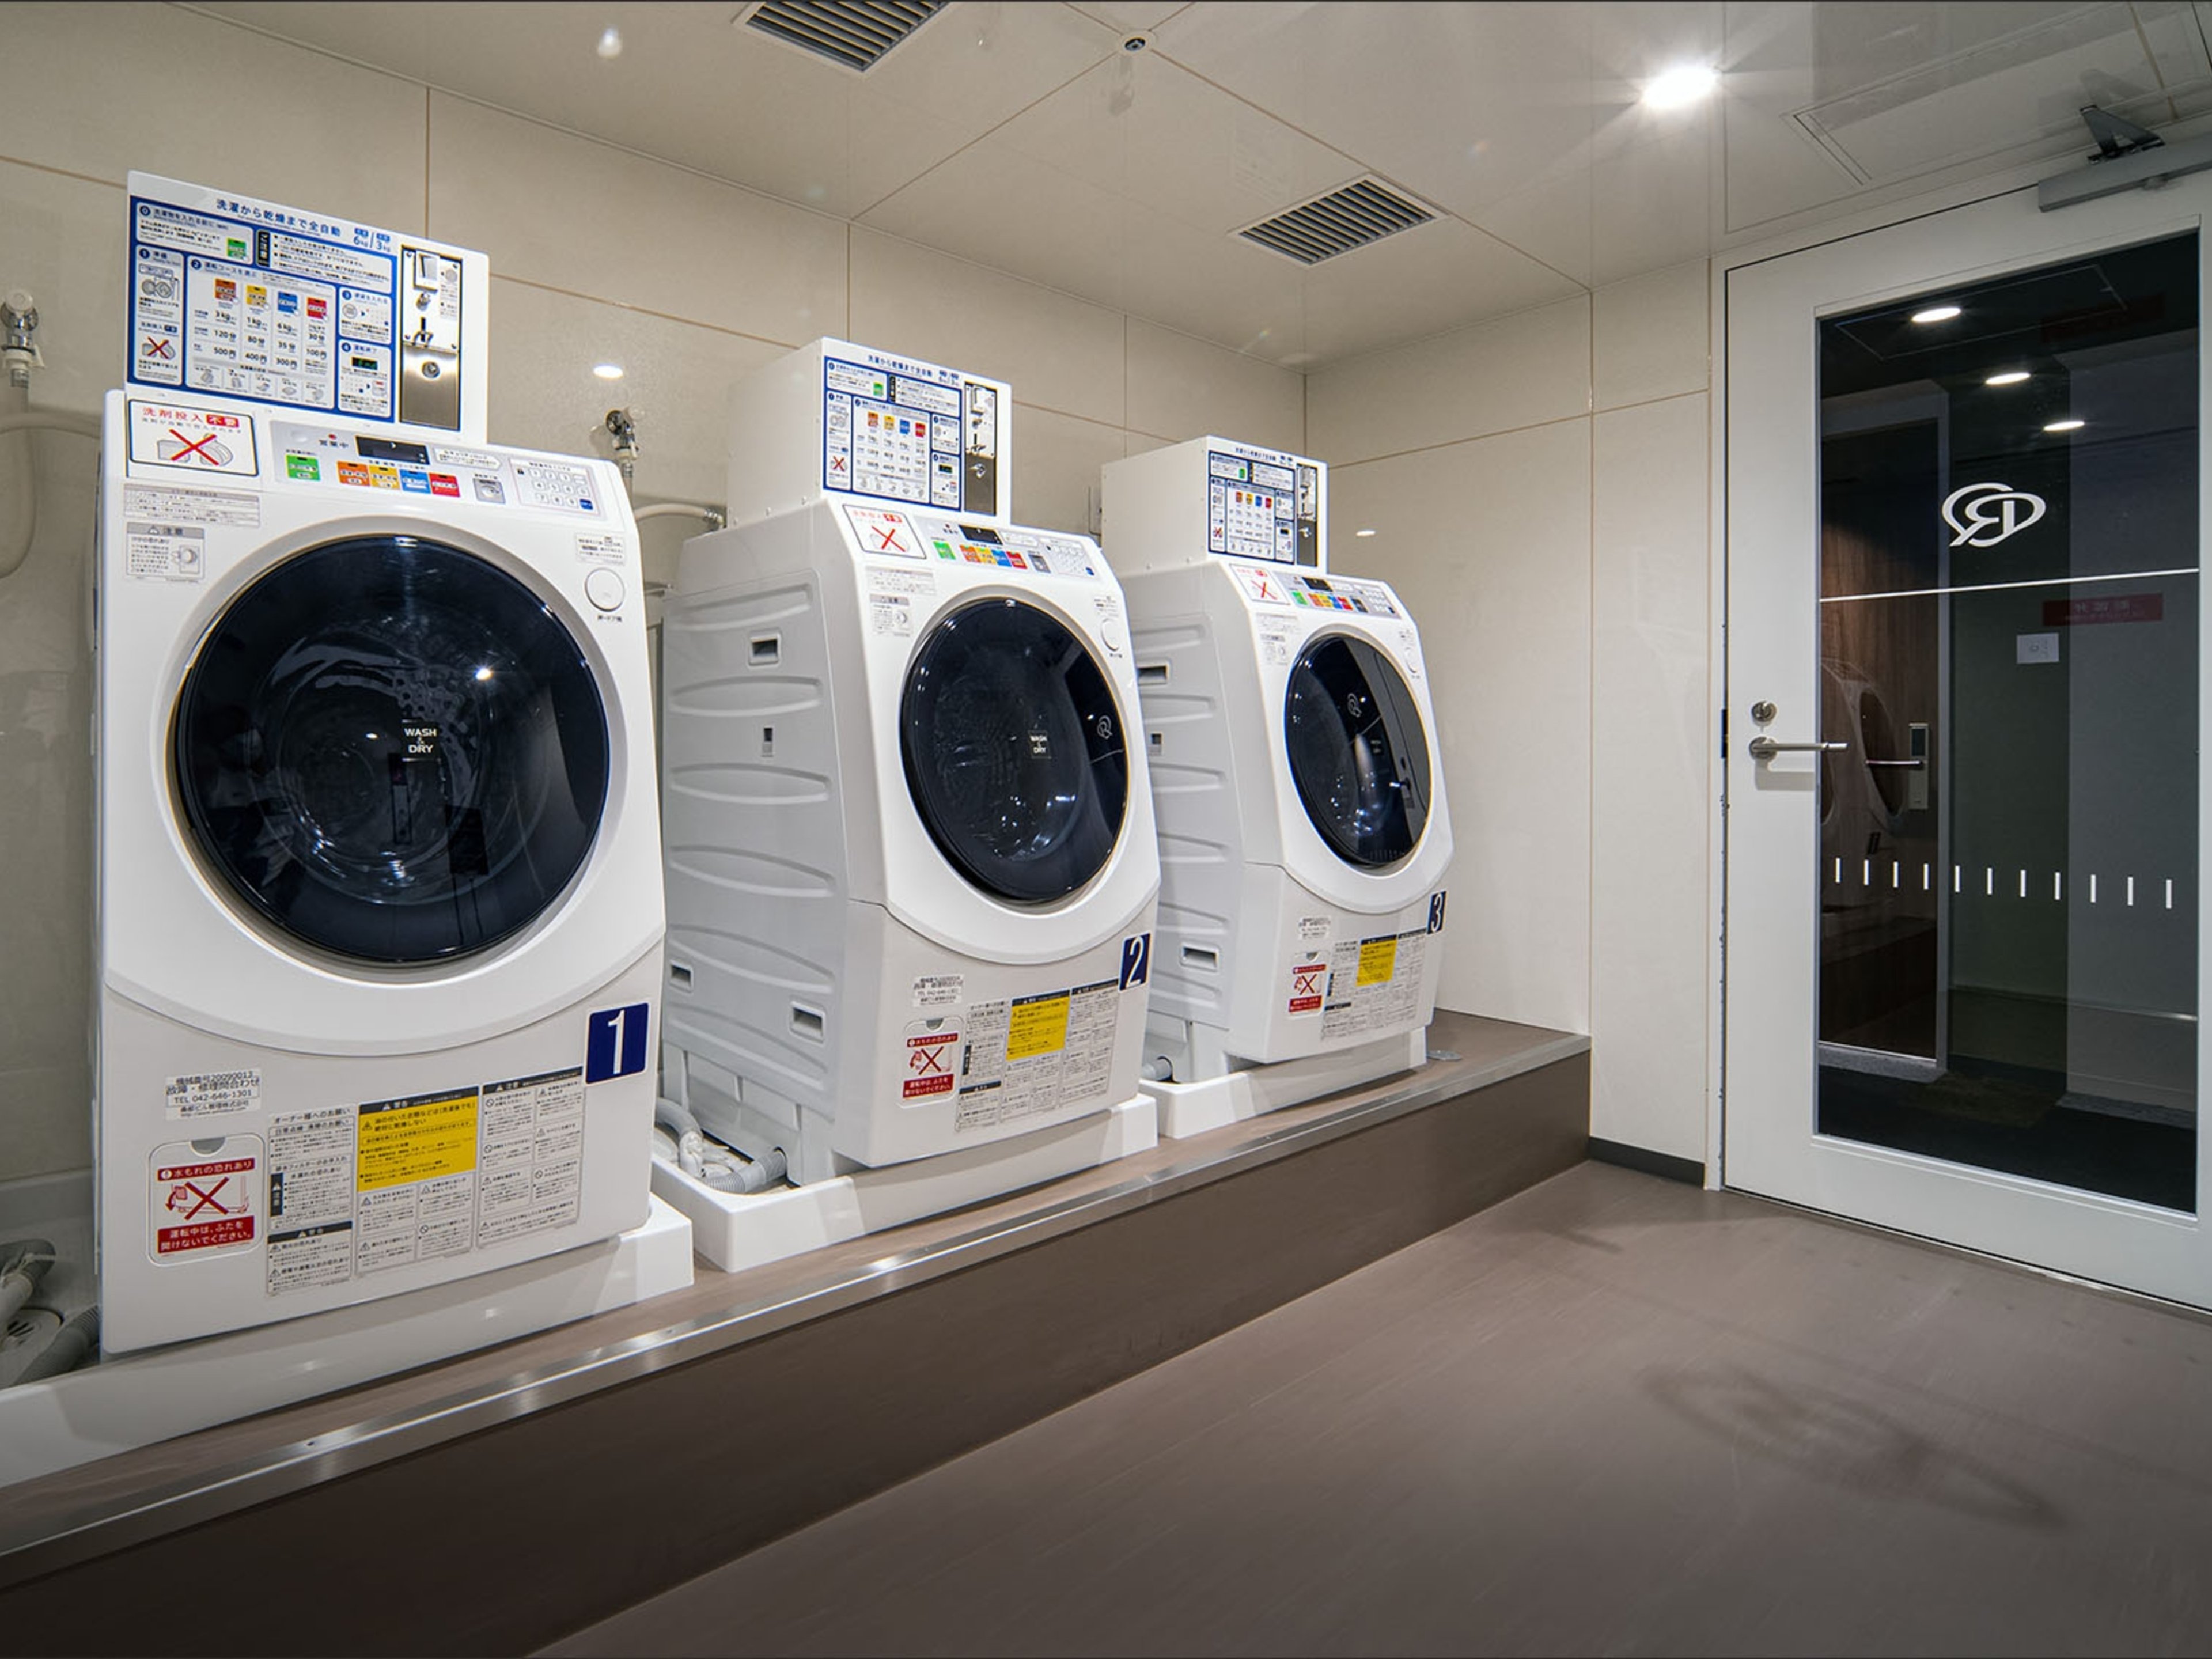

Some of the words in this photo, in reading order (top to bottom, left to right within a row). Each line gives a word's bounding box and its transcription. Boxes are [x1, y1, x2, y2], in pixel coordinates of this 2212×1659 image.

[216, 199, 341, 237] 洗濯から乾燥まで全自動
[143, 407, 203, 423] 洗剤投入
[404, 728, 437, 736] WASH
[408, 745, 433, 753] DRY
[1431, 893, 1442, 933] 3
[1127, 935, 1145, 987] 2
[608, 1009, 625, 1075] 1
[192, 1089, 251, 1103] 042-646-1301
[275, 1108, 350, 1123] オーナー様へのお願い
[174, 1161, 252, 1177] 水もれの恐れあり
[170, 1221, 243, 1238] 運転中は、ふたを
[161, 1232, 251, 1251] 開けないでください。
